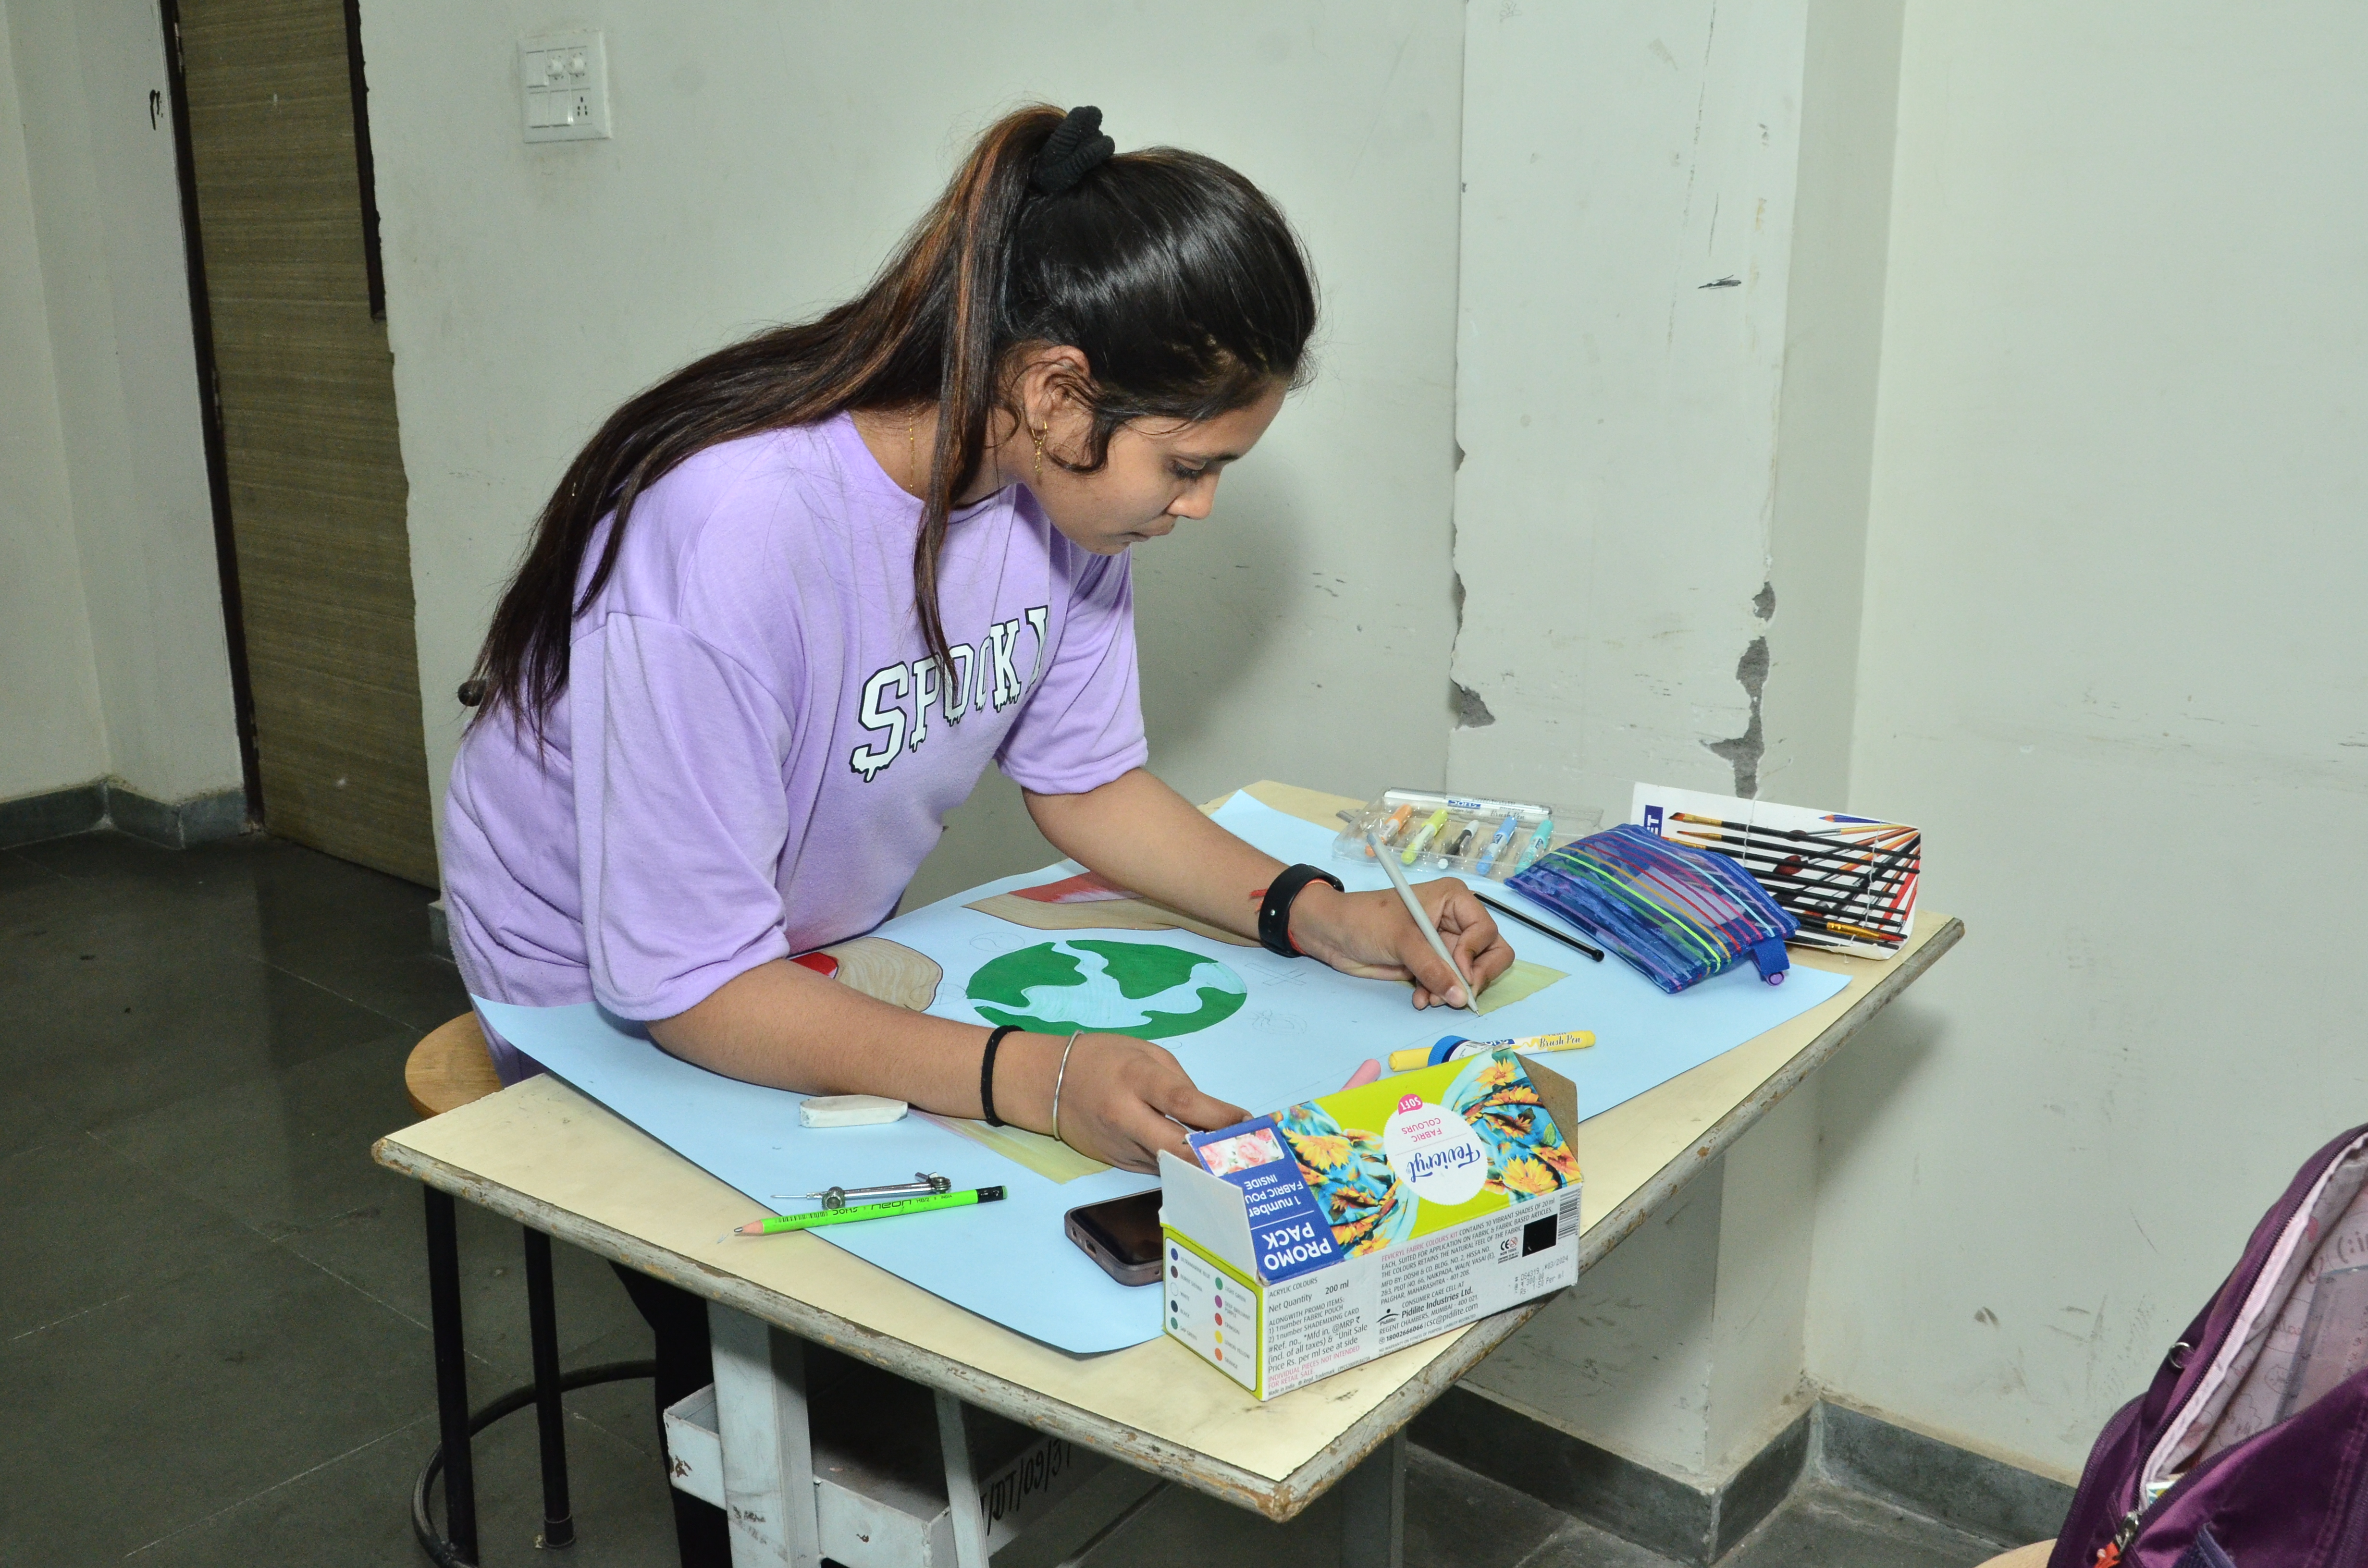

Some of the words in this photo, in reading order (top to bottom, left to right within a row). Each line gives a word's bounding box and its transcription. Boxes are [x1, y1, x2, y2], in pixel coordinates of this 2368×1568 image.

[1540, 1035, 1564, 1048] Brush
[1566, 1034, 1582, 1044] Pen
[1399, 1096, 1422, 1111] SOFT
[1401, 1117, 1441, 1135] COLOURS
[1410, 1127, 1443, 1142] FABRIC
[1407, 1143, 1480, 1183] Fevicryl
[1244, 1174, 1277, 1188] INSIDE
[1269, 1180, 1304, 1196] FABRIC
[1248, 1197, 1291, 1218] number
[1293, 1194, 1301, 1206] 1
[1261, 1222, 1314, 1250] PACK
[1381, 1249, 1405, 1262] FEVICRYL
[1406, 1243, 1424, 1253] FABRIC
[1425, 1235, 1449, 1247] COLOURS
[1459, 1223, 1484, 1236] CONTAINS
[1492, 1213, 1514, 1224] VIBRANT
[1515, 1206, 1533, 1216] SHADES
[1381, 1260, 1397, 1270] EACH,
[1398, 1253, 1416, 1264] SUITED
[1418, 1250, 1428, 1258] FOR
[1429, 1238, 1462, 1254] APPLICATION
[1463, 1235, 1470, 1243] ON
[1472, 1228, 1490, 1239] FABRIC
[1495, 1221, 1513, 1231] FABRIC
[1514, 1215, 1529, 1225] BASED
[1264, 1237, 1332, 1271] PROMO
[1393, 1262, 1416, 1274] COLOURS
[1418, 1254, 1439, 1266] RETAINS
[1450, 1242, 1474, 1254] NATURAL
[1475, 1238, 1485, 1246] FEEL
[1381, 1279, 1393, 1288] MFD
[1404, 1270, 1419, 1280] DOSHI
[1467, 1249, 1480, 1258] HISSA
[1394, 1283, 1406, 1292] PLOT
[1472, 1255, 1486, 1265] VASAI
[1268, 1303, 1281, 1313] Net
[1283, 1294, 1312, 1309] Quantity
[1325, 1284, 1338, 1294] 200
[1340, 1279, 1349, 1290] ml
[1269, 1286, 1291, 1298] ACRYLIC
[1293, 1277, 1318, 1290] COLOURS
[1402, 1293, 1430, 1308] CONSUMER
[1431, 1288, 1444, 1298] CARE
[1445, 1284, 1456, 1292] CELL
[1407, 1278, 1445, 1295] MAHARASHTRA
[1268, 1311, 1303, 1326] ALONGWITH
[1305, 1302, 1325, 1315] PROMO
[1327, 1297, 1344, 1307] ITEMS:
[1402, 1304, 1424, 1318] Pidilite
[1426, 1291, 1459, 1309] Industries
[1461, 1286, 1473, 1297] Ltd.
[1269, 1327, 1274, 1335] 1)
[1304, 1311, 1322, 1323] FABRIC
[1325, 1304, 1343, 1315] POUCH
[1269, 1335, 1274, 1344] 2)
[1304, 1313, 1343, 1331] SHADEMIXING
[1344, 1307, 1359, 1317] CARD
[1332, 1318, 1354, 1333] @MRP
[1379, 1323, 1399, 1335] REGENT
[1431, 1303, 1453, 1316] MUMBAI
[1457, 1298, 1467, 1306] 400
[1380, 1316, 1396, 1326] Pidilite
[1268, 1351, 1284, 1365] (incl.
[1286, 1348, 1293, 1358] of
[1295, 1345, 1304, 1354] all
[1305, 1337, 1326, 1352] taxes)
[1328, 1335, 1332, 1344] &
[1354, 1323, 1368, 1334] Sale
[1386, 1323, 1423, 1341] 18002666066
[1268, 1361, 1284, 1374] Price
[1286, 1358, 1296, 1367] Rs.
[1298, 1354, 1309, 1365] per
[1311, 1348, 1320, 1359] ml
[1322, 1345, 1334, 1355] see
[1336, 1341, 1343, 1350] at
[1344, 1336, 1358, 1347] side
[1268, 1366, 1299, 1383] INDIVIDUAL
[1302, 1360, 1319, 1370] PIECES
[1321, 1355, 1332, 1363] NOT
[1333, 1345, 1359, 1359] INTENDED
[1268, 1380, 1279, 1389] FOR
[1281, 1373, 1298, 1384] RETAIL
